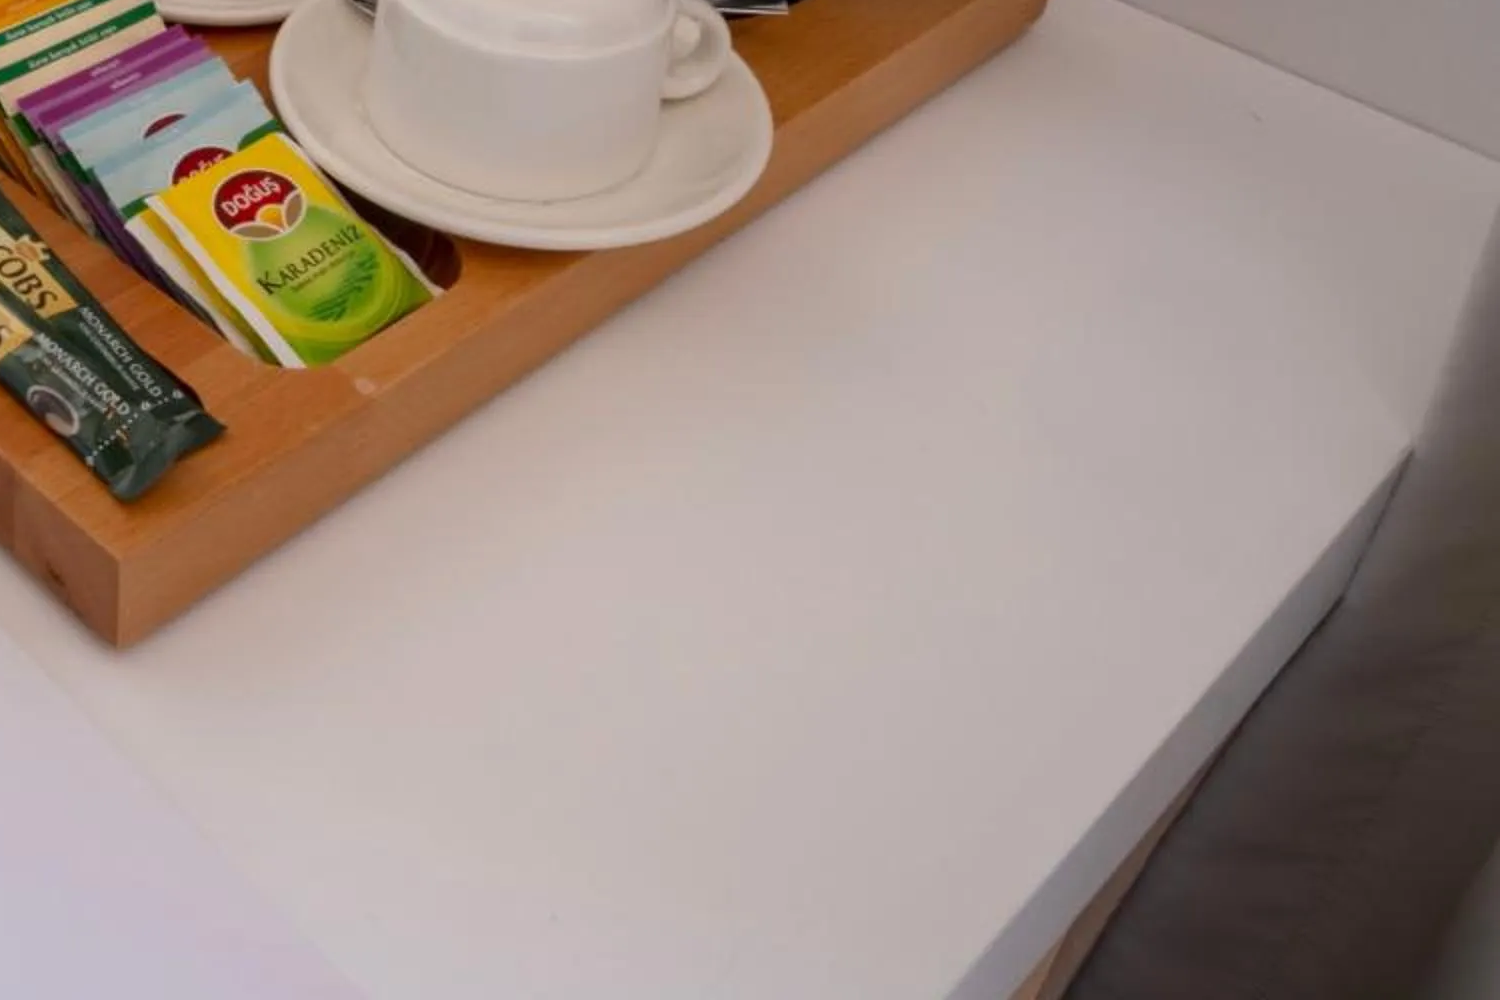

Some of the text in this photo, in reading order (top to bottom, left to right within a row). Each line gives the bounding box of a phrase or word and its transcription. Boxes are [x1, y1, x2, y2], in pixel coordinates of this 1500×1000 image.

[35, 332, 97, 389] MONARCH
[78, 305, 133, 364] MONARCH
[128, 362, 162, 398] GOLD
